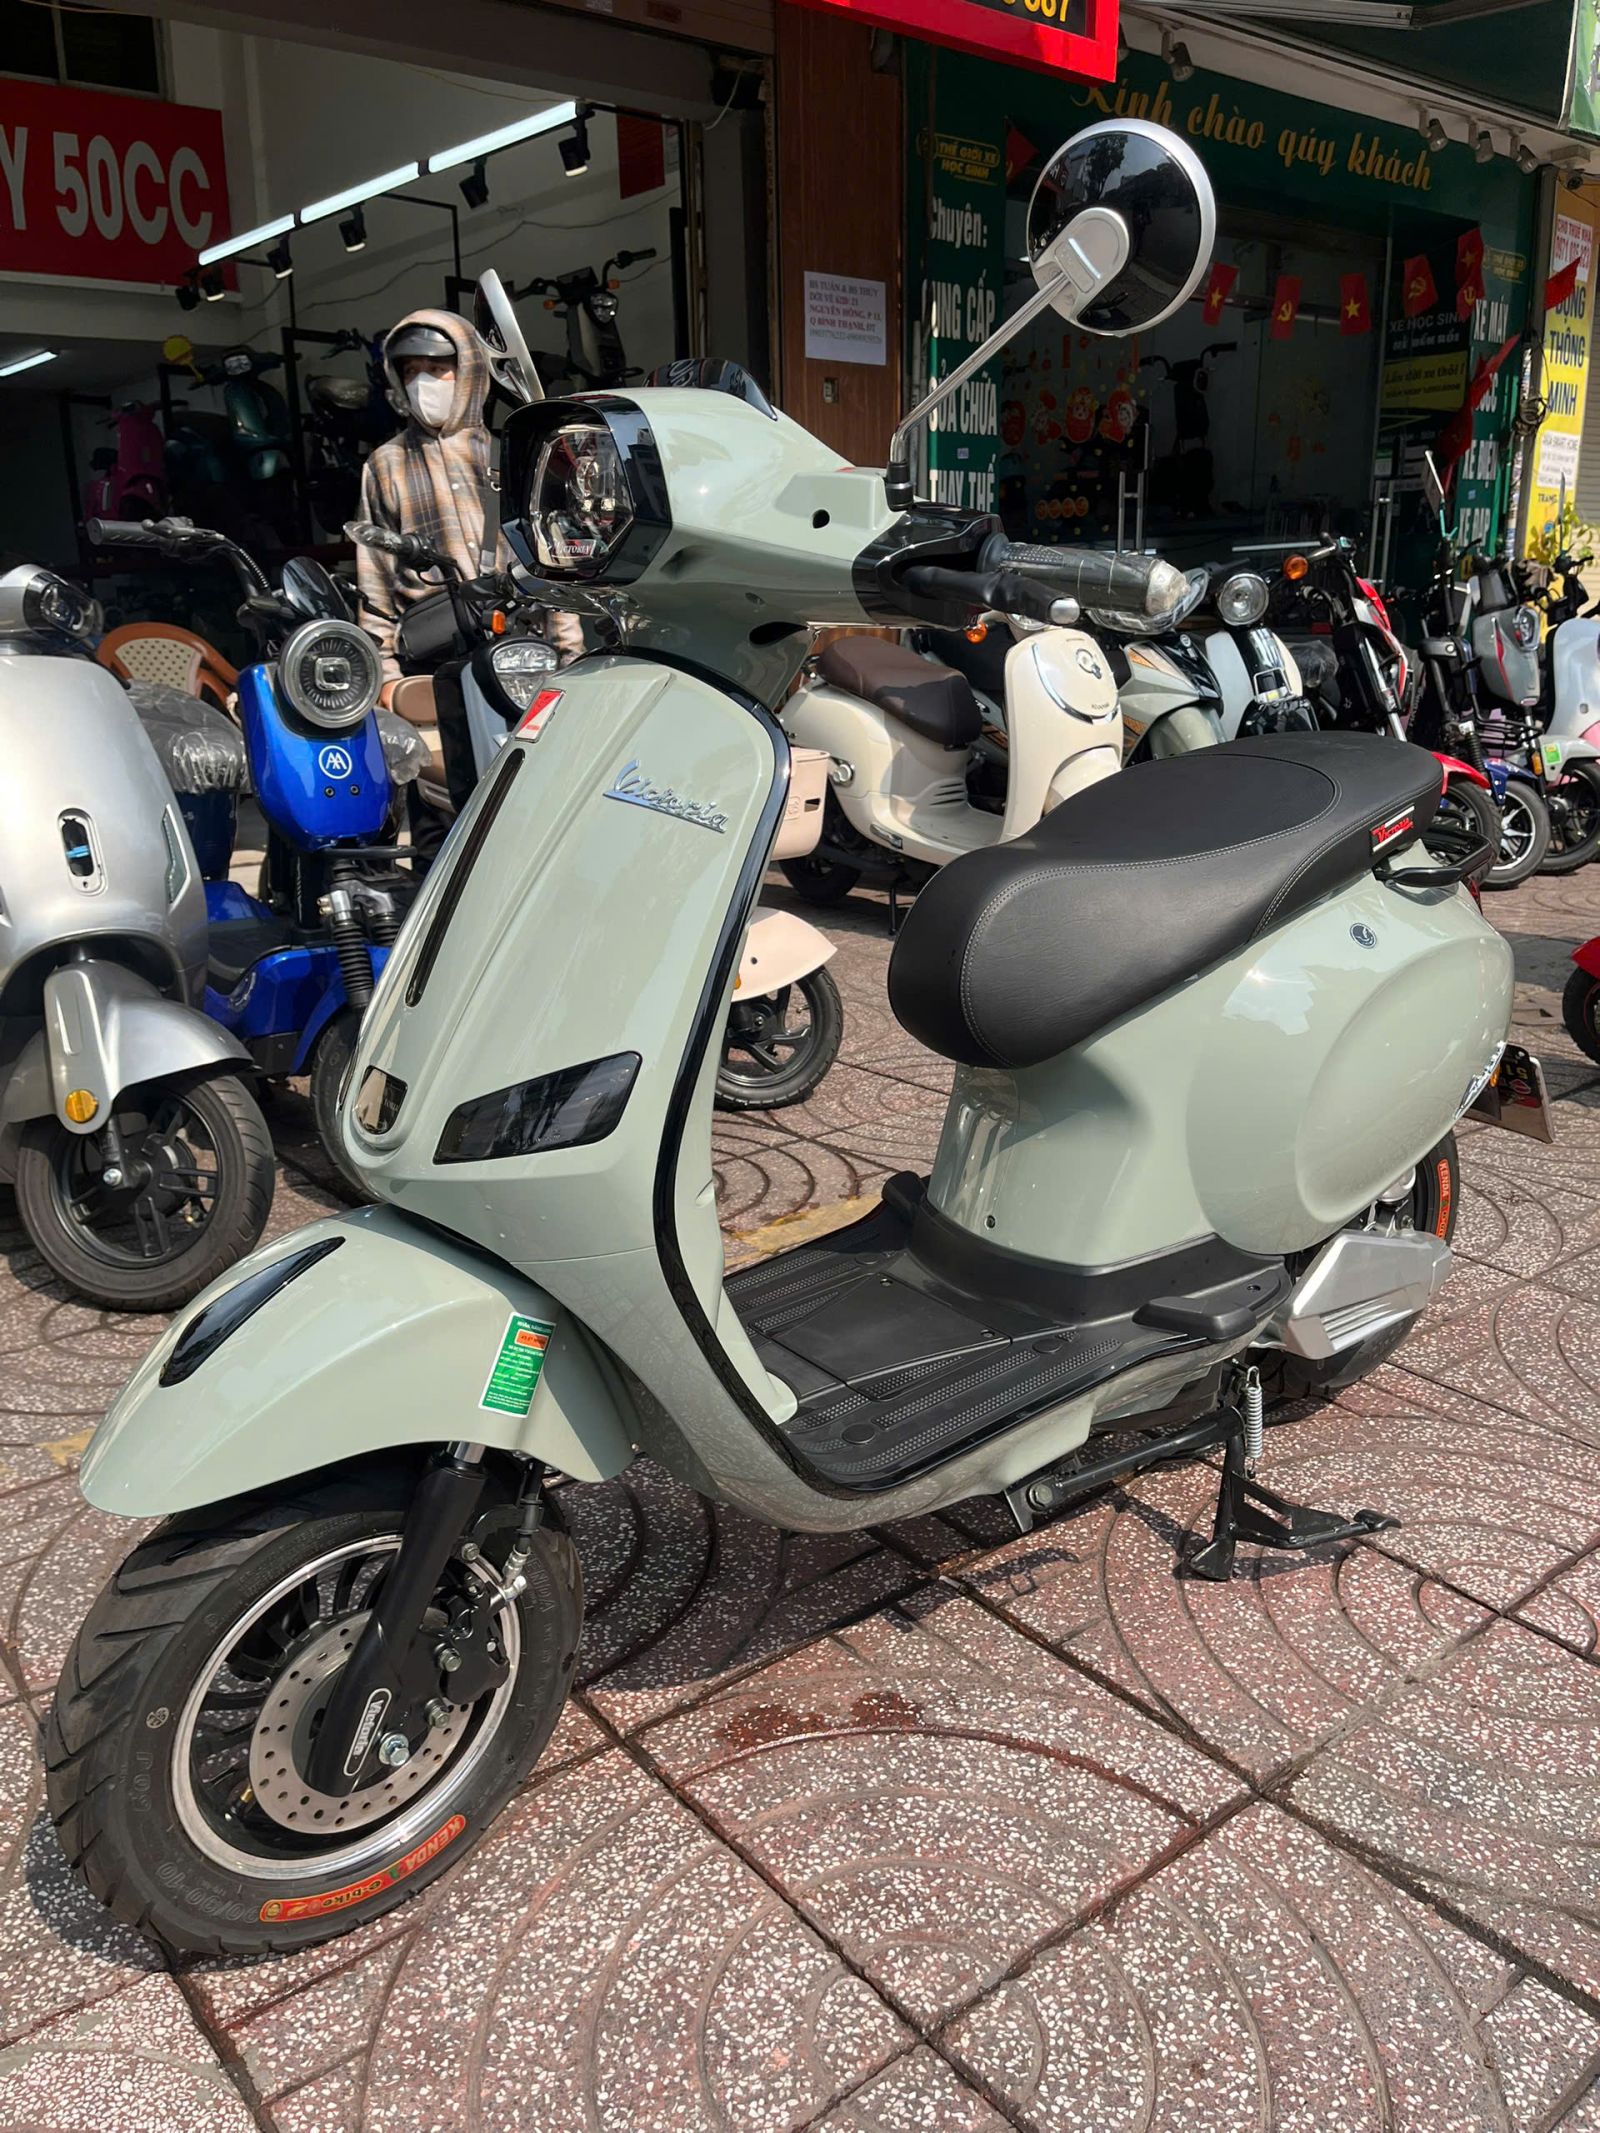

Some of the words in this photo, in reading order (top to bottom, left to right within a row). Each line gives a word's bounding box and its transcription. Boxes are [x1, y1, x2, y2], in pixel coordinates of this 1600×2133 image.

[1186, 94, 1266, 148] chào
[1347, 132, 1432, 191] khách
[53, 131, 213, 249] 50CC
[966, 268, 996, 342] CẤP
[1474, 298, 1487, 341] XE
[1549, 327, 1585, 367] THÔNG
[1547, 380, 1578, 416] MINH
[404, 1818, 461, 1870] KENDA
[322, 1880, 382, 1908] e-bike
